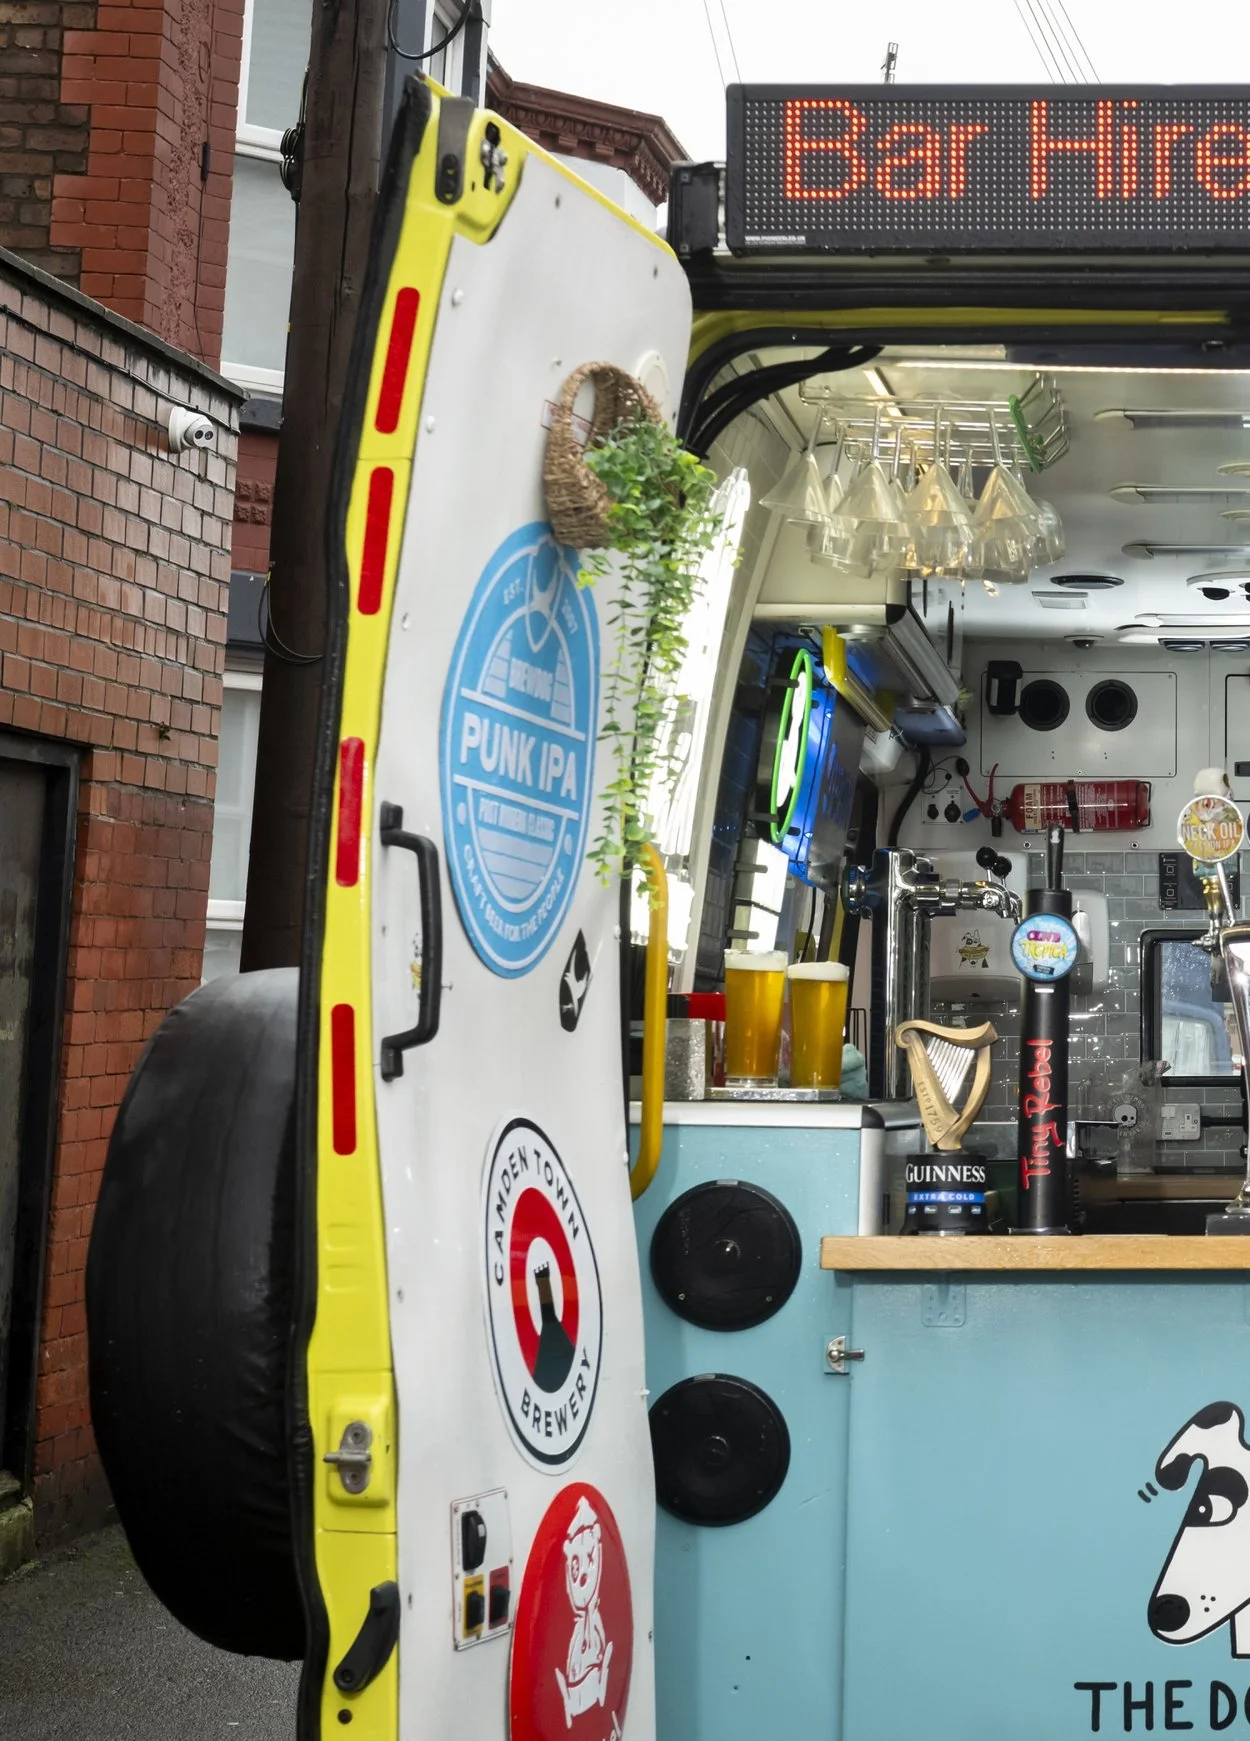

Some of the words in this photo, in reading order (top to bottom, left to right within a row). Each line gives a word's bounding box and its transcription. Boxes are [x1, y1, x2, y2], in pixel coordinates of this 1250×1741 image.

[786, 99, 989, 199] Bar
[460, 711, 536, 787] PUNK
[538, 741, 577, 801] IPA
[1025, 792, 1033, 820] FOAM
[1181, 822, 1217, 841] NECK
[1220, 821, 1241, 839] OIL
[1023, 1039, 1062, 1119] Rebel
[925, 1105, 943, 1133] 1759
[905, 1163, 986, 1183] GUINNESS
[1019, 1120, 1065, 1190] Tiny
[493, 1144, 529, 1287] CAMDEN
[533, 1148, 580, 1241] TOWN
[913, 1192, 946, 1201] EXTRA
[948, 1192, 976, 1201] COLD
[520, 1345, 591, 1438] BREWERY
[1073, 1679, 1194, 1732] THE
